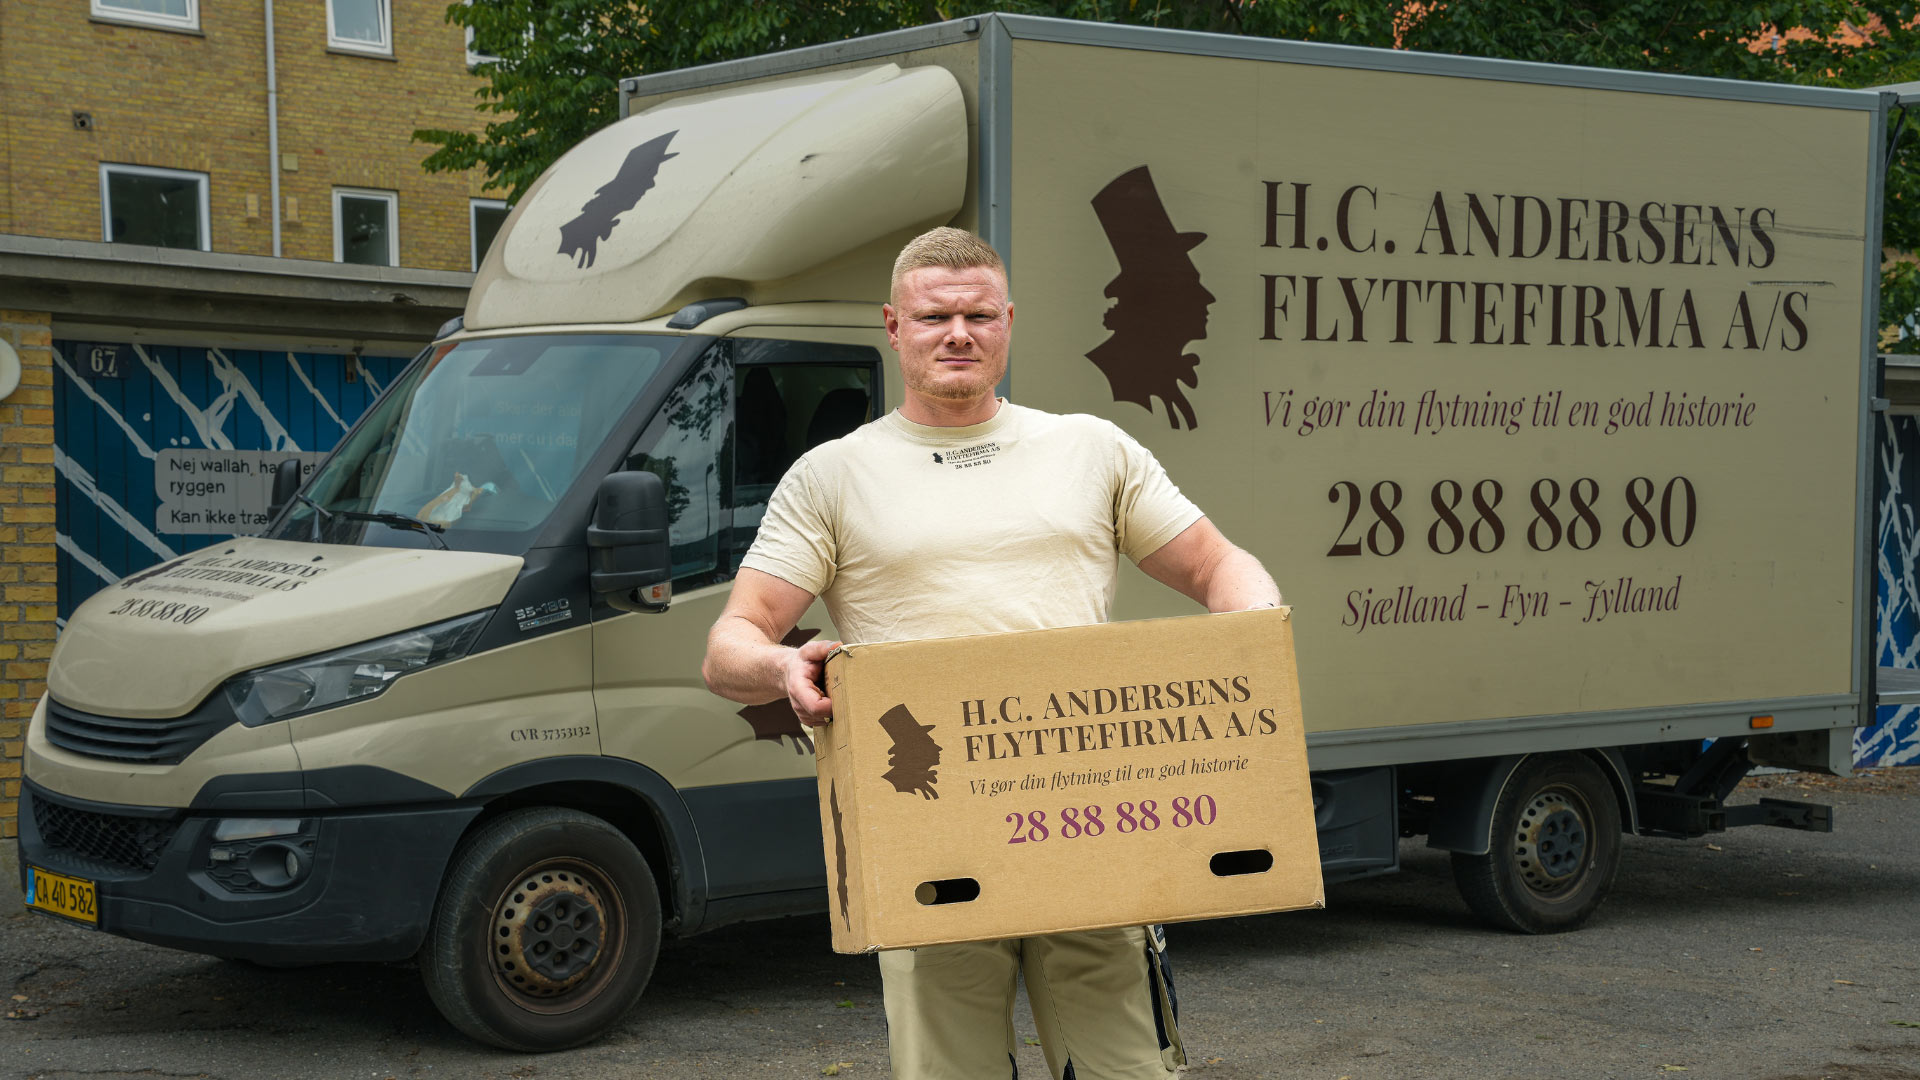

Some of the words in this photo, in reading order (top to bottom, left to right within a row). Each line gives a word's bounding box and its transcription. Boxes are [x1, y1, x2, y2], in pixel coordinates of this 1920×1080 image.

[1260, 180, 1396, 254] H.C.
[1415, 191, 1776, 269] ANDERSENS
[1259, 274, 1706, 349] FLYTTEFIRMA
[1722, 290, 1809, 351] A/S
[91, 348, 116, 373] 67
[1262, 389, 1293, 428] Vi
[1298, 395, 1351, 437] gør
[1358, 389, 1405, 428] din
[1414, 389, 1525, 436] flytning
[1532, 390, 1562, 428] til
[1568, 399, 1599, 428] en
[1604, 391, 1652, 436] god
[1659, 391, 1756, 428] historie
[170, 458, 196, 475] Nej
[201, 459, 253, 476] wallah,
[259, 461, 279, 474] ha
[303, 463, 316, 474] et
[170, 480, 225, 497] ryggen
[171, 509, 201, 525] Kan
[205, 509, 236, 525] ikke
[239, 510, 270, 525] træ
[1326, 480, 1405, 557] 28
[1427, 479, 1506, 555] 88
[1526, 477, 1602, 552] 88
[1622, 475, 1697, 549] 80
[1341, 583, 1469, 635] Sjælland
[1498, 582, 1550, 626] Fyn
[1582, 575, 1683, 624] Jylland
[960, 696, 1033, 727] H.C.
[1042, 675, 1251, 720] ANDERSENS
[510, 728, 539, 742] CVR
[964, 713, 1214, 762] FLYTTEFIRMA
[1224, 708, 1277, 739] A/S
[969, 778, 986, 795] Vi
[990, 779, 1016, 797] gør
[1020, 774, 1046, 791] din
[1050, 769, 1112, 791] flytning
[1115, 765, 1132, 781] til
[1136, 766, 1155, 780] en
[1159, 758, 1186, 780] god
[1190, 754, 1249, 775] historie
[1005, 810, 1050, 845] 28
[1060, 804, 1105, 839] 88
[1116, 799, 1161, 833] 88
[1172, 794, 1218, 828] 80
[36, 876, 49, 905] CA
[52, 880, 66, 909] 40
[69, 884, 94, 915] 582
